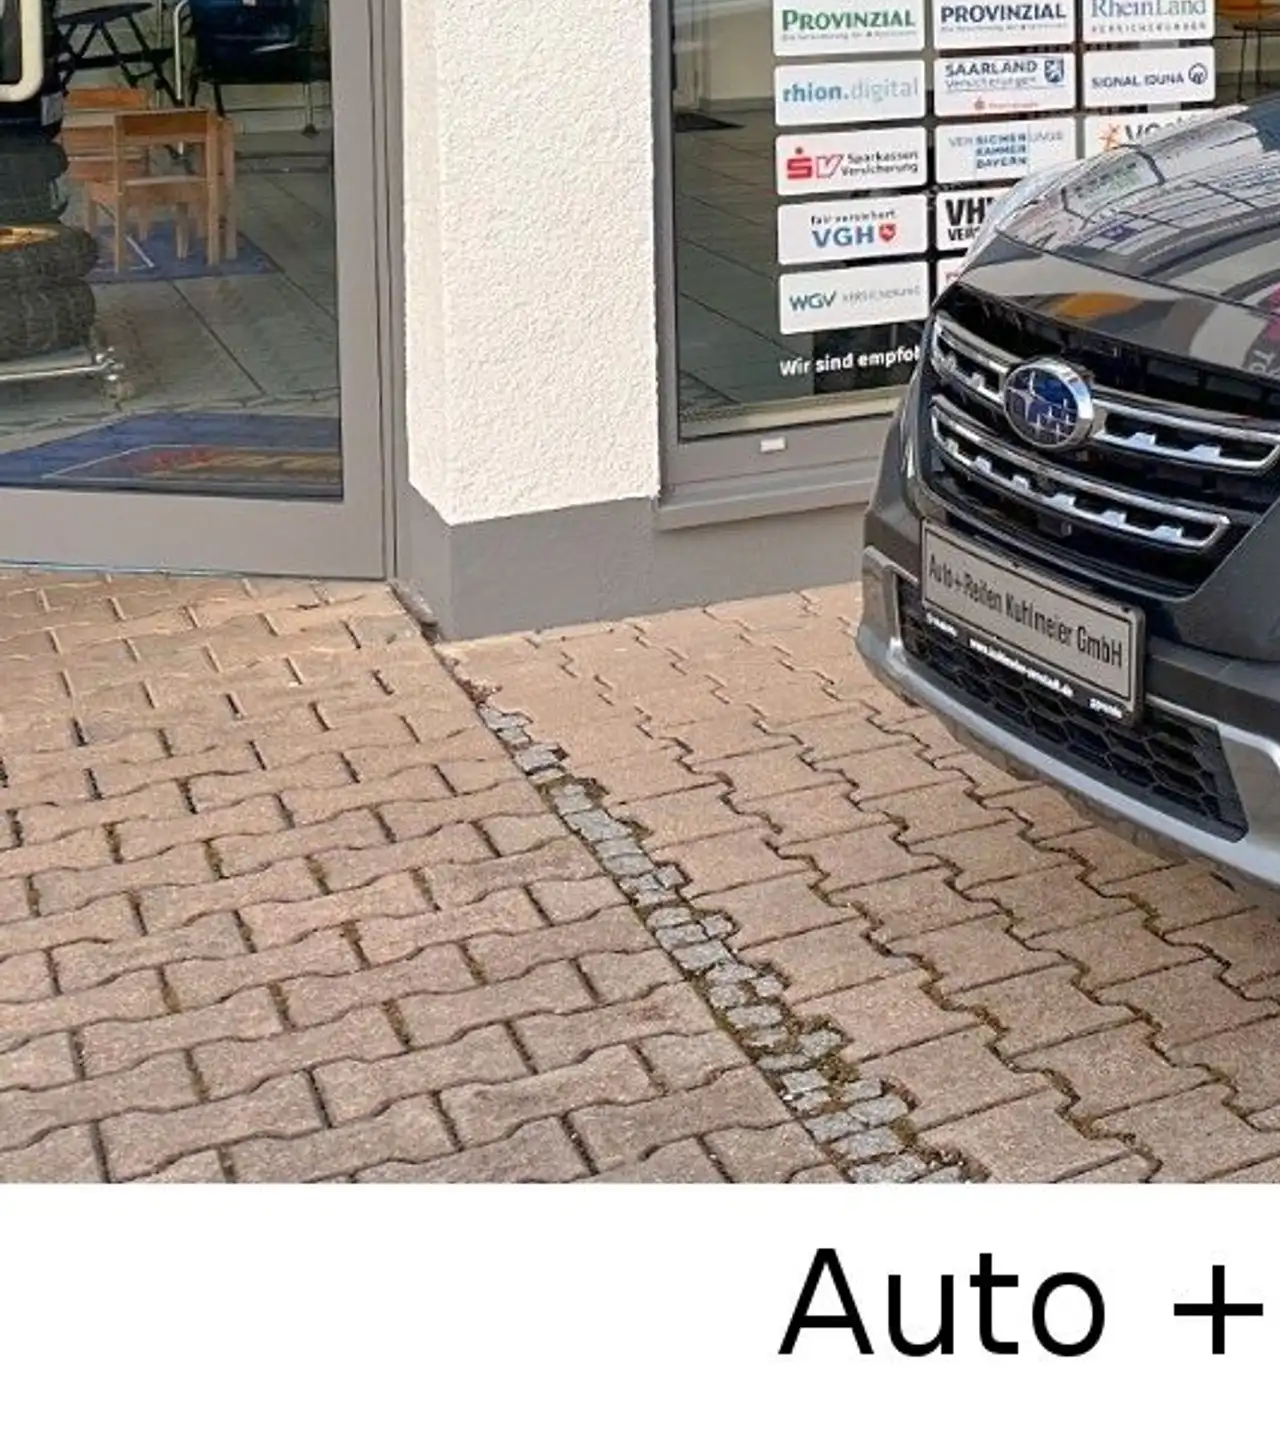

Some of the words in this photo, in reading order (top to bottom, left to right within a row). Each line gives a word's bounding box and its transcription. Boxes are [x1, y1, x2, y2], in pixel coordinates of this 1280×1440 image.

[940, 2, 1068, 24] PROVINZIAL
[945, 60, 1038, 78] SAARLAND
[782, 76, 919, 102] rhion.digital
[1091, 75, 1142, 90] SIGNAL
[1144, 72, 1185, 86] IDUNA
[811, 225, 875, 248] VGH
[788, 290, 837, 312] WGV
[779, 356, 812, 377] Wir
[815, 352, 854, 373] sind
[1005, 590, 1074, 648] Kuhlmeier
[1076, 624, 1123, 669] GmbH
